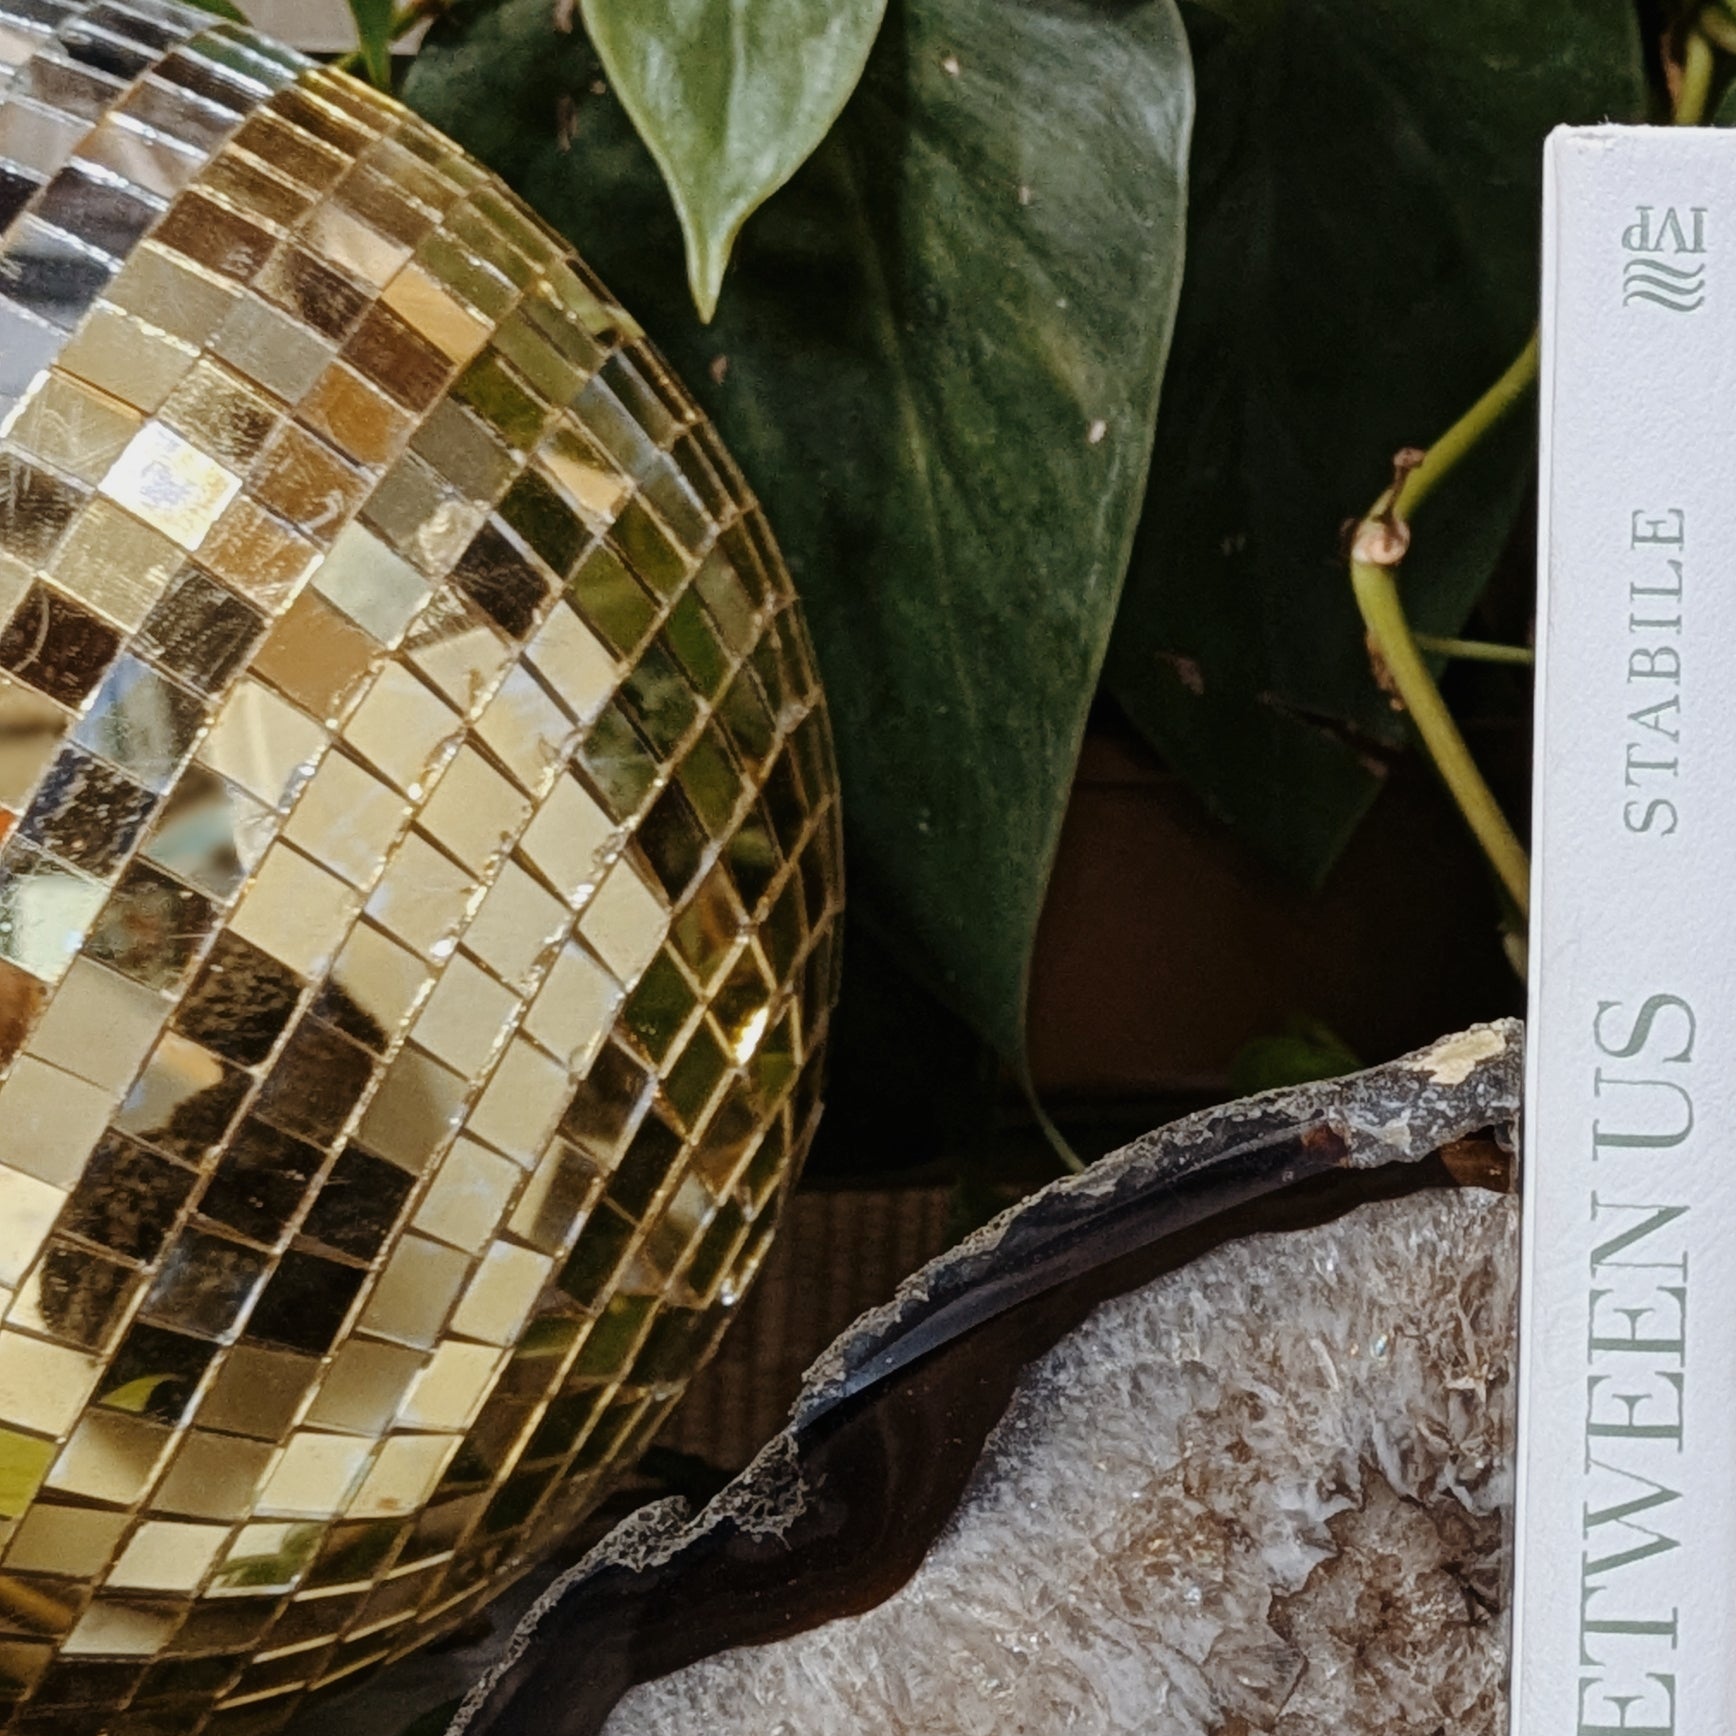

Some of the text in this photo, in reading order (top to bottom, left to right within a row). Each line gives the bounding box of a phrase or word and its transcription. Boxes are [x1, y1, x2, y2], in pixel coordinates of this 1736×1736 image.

[1622, 207, 1708, 253] IVP
[1624, 508, 1686, 837] STABILE
[1592, 993, 1697, 1161] US
